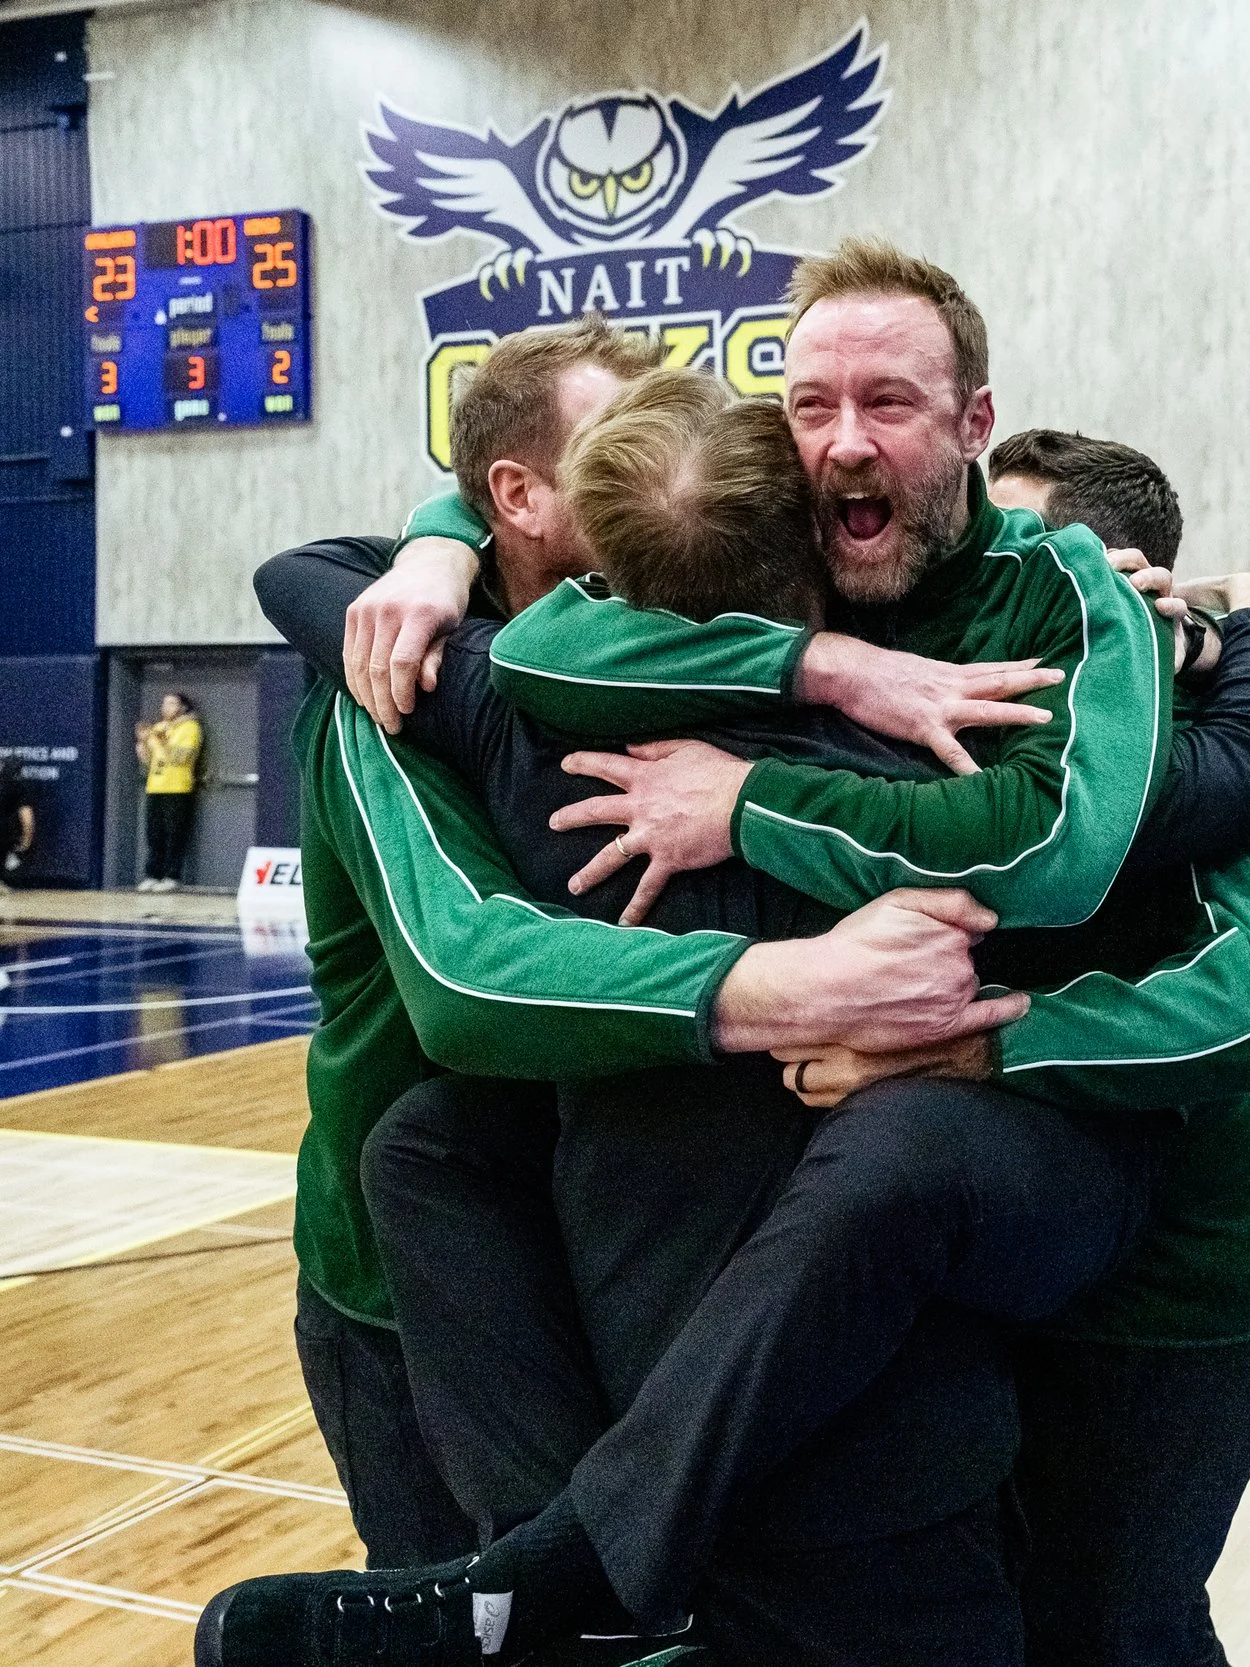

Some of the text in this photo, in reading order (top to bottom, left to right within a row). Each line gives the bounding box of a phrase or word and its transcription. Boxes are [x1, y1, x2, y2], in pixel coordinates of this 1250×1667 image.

[177, 218, 237, 266] 1:00
[252, 241, 298, 289] 25
[92, 255, 137, 302] 23
[537, 257, 691, 317] NAIT
[101, 361, 118, 394] 3
[187, 355, 206, 390] 3
[271, 350, 291, 385] 2
